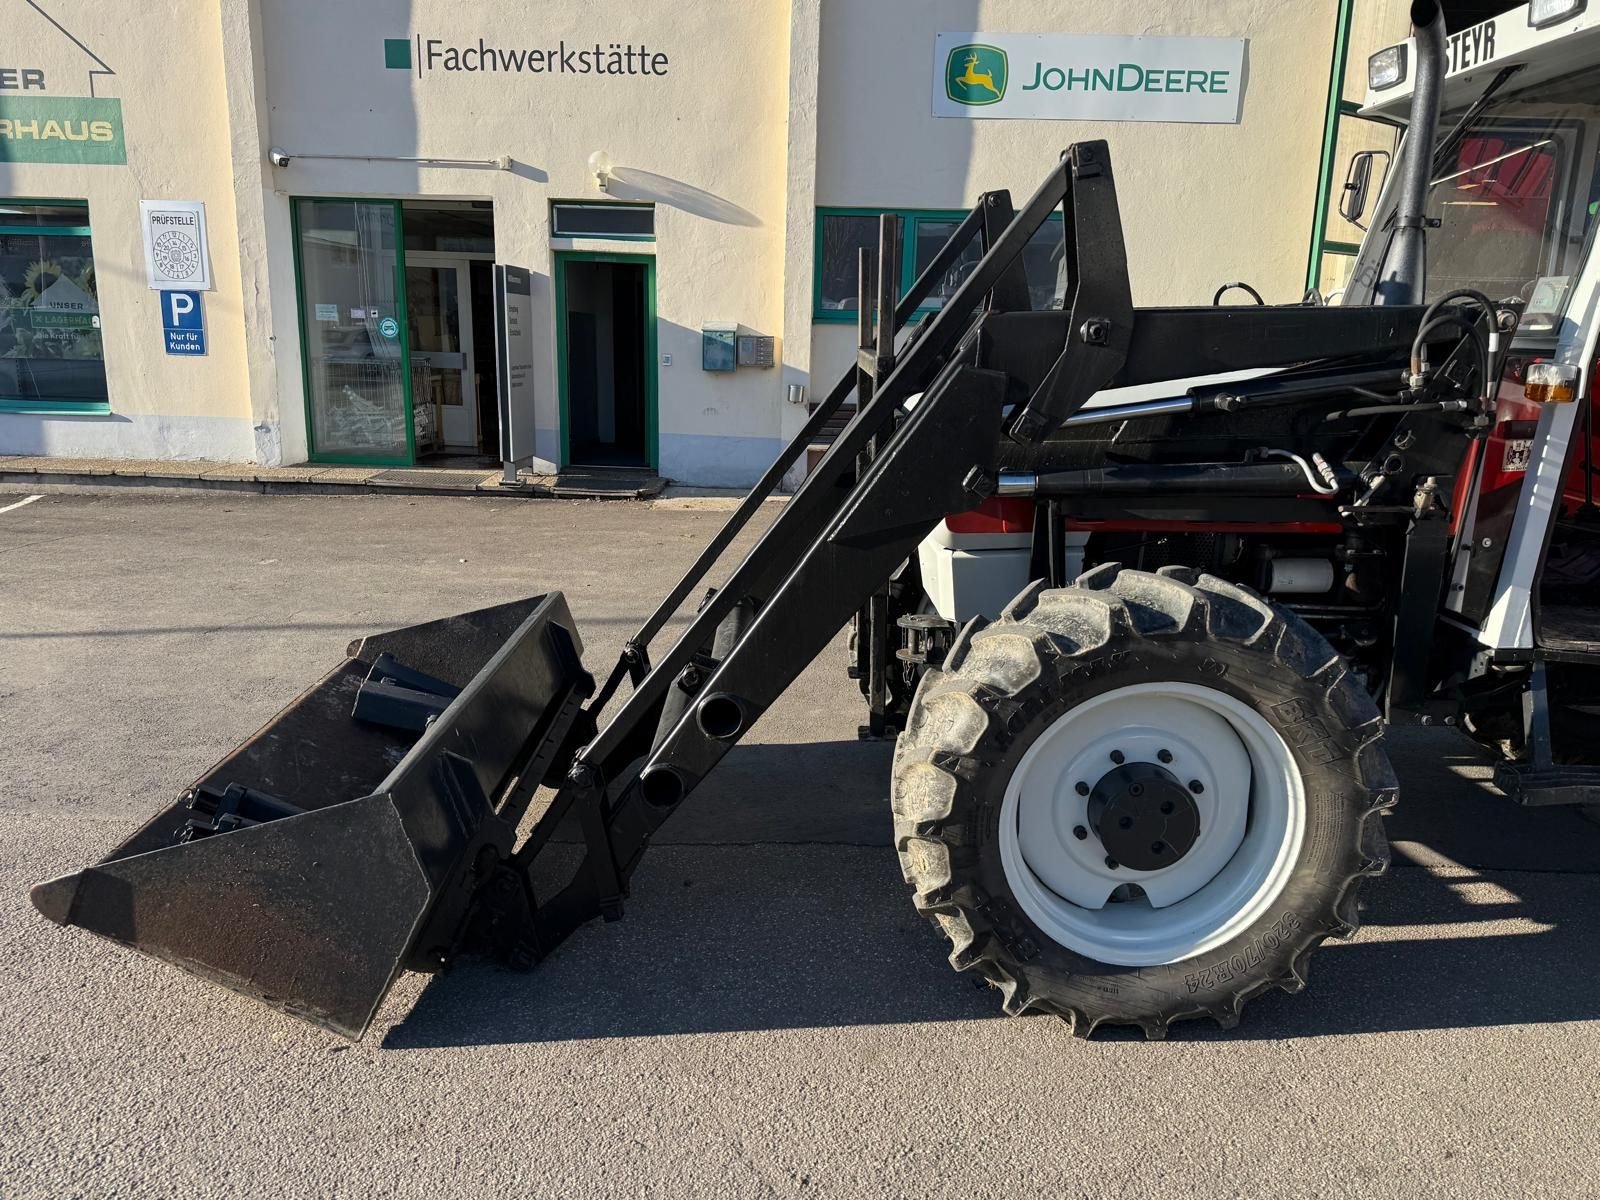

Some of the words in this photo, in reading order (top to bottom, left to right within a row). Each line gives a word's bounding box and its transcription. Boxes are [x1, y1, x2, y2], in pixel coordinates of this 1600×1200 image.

[426, 38, 669, 76] Fachwerkstätte
[151, 214, 195, 226] PRÜFSTELLE
[170, 293, 194, 326] P
[170, 332, 185, 341] Nur
[186, 332, 199, 341] für
[170, 341, 201, 351] Kunden
[1184, 911, 1301, 994] 320/70R24
